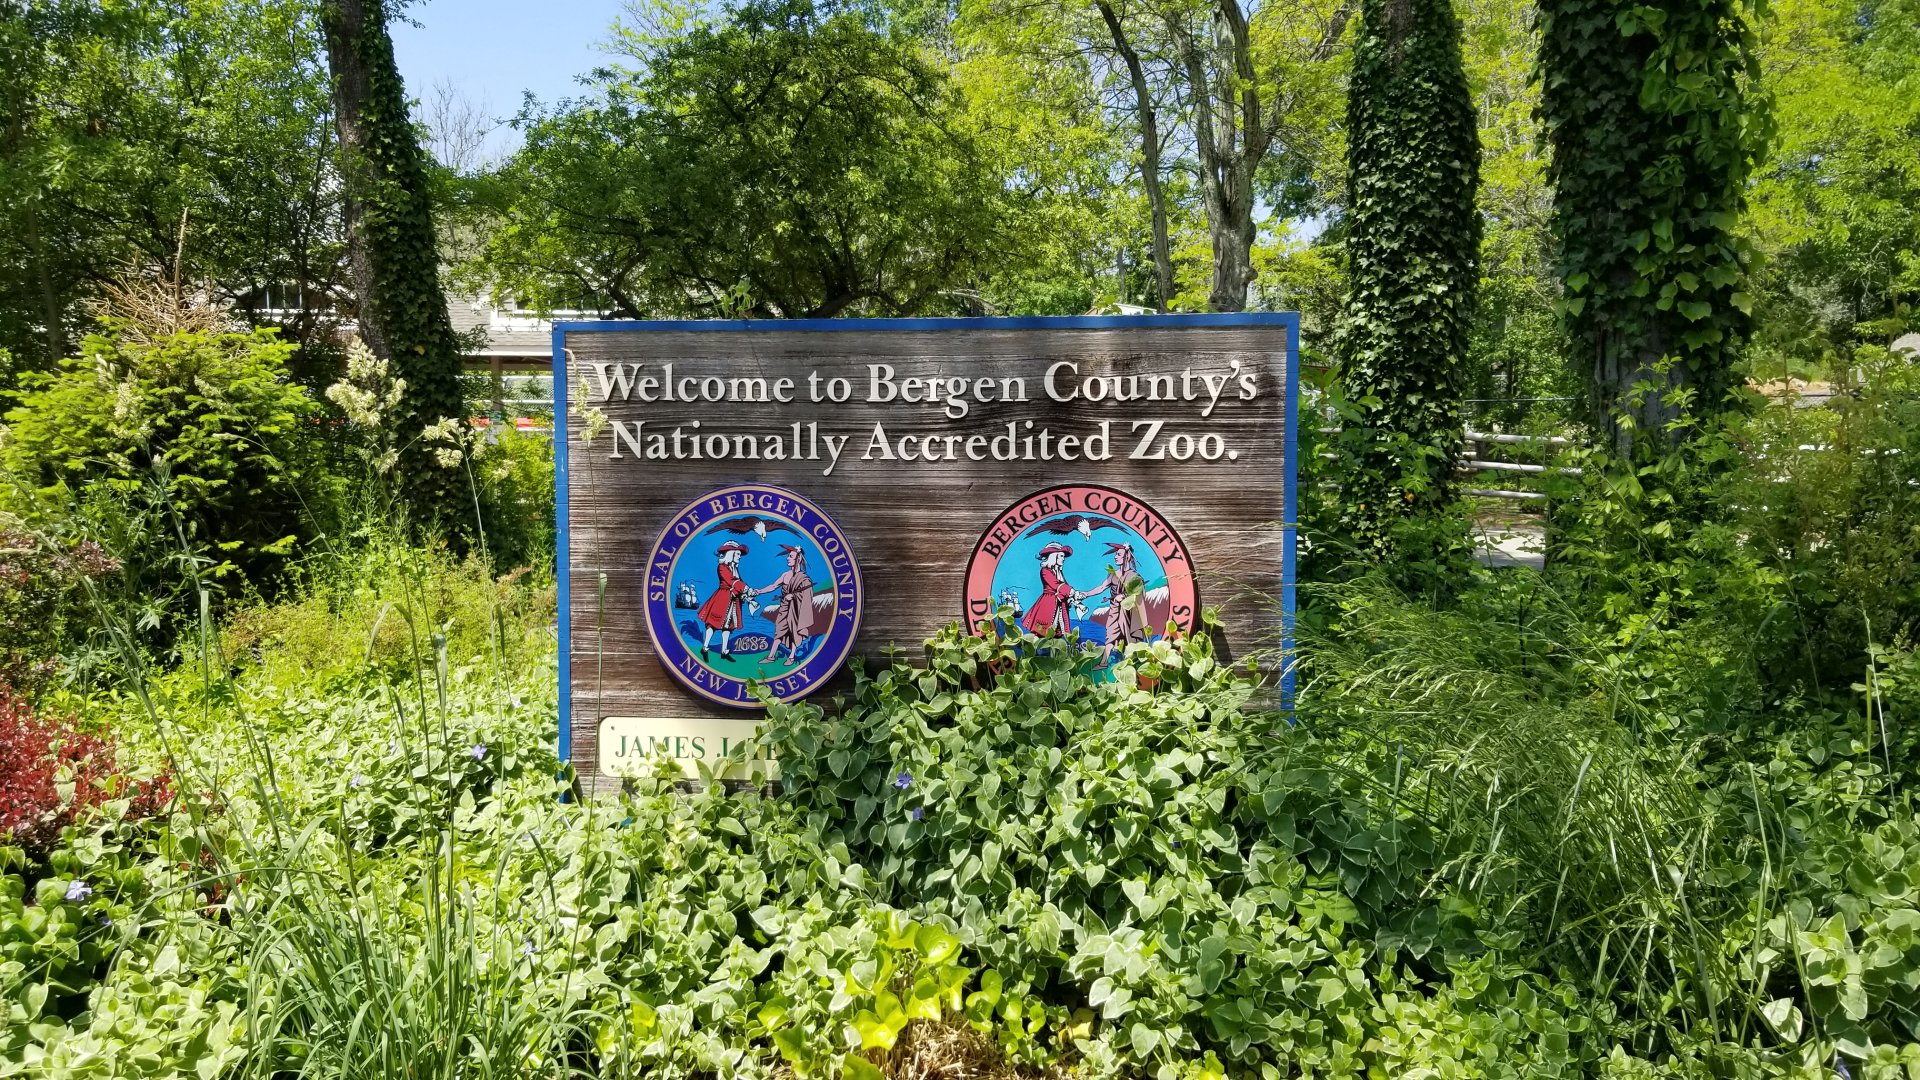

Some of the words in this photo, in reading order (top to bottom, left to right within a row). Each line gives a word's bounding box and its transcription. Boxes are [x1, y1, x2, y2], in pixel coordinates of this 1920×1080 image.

[593, 363, 795, 403] Welcome
[807, 370, 851, 403] to
[866, 364, 1031, 419] Bergen
[1044, 360, 1257, 417] County's
[608, 420, 850, 476] Nationally
[861, 420, 1113, 461] Accredited
[1128, 420, 1239, 461] Zoo.
[981, 491, 1073, 560] BERGEN
[1084, 492, 1184, 565] COUNTY
[651, 546, 677, 602] SEAL
[675, 510, 701, 537] OF
[709, 492, 809, 523] BERGEN
[812, 522, 855, 621] COUNTY
[732, 636, 769, 652] 1683
[679, 656, 728, 692] NEW
[614, 735, 706, 760] JAMES
